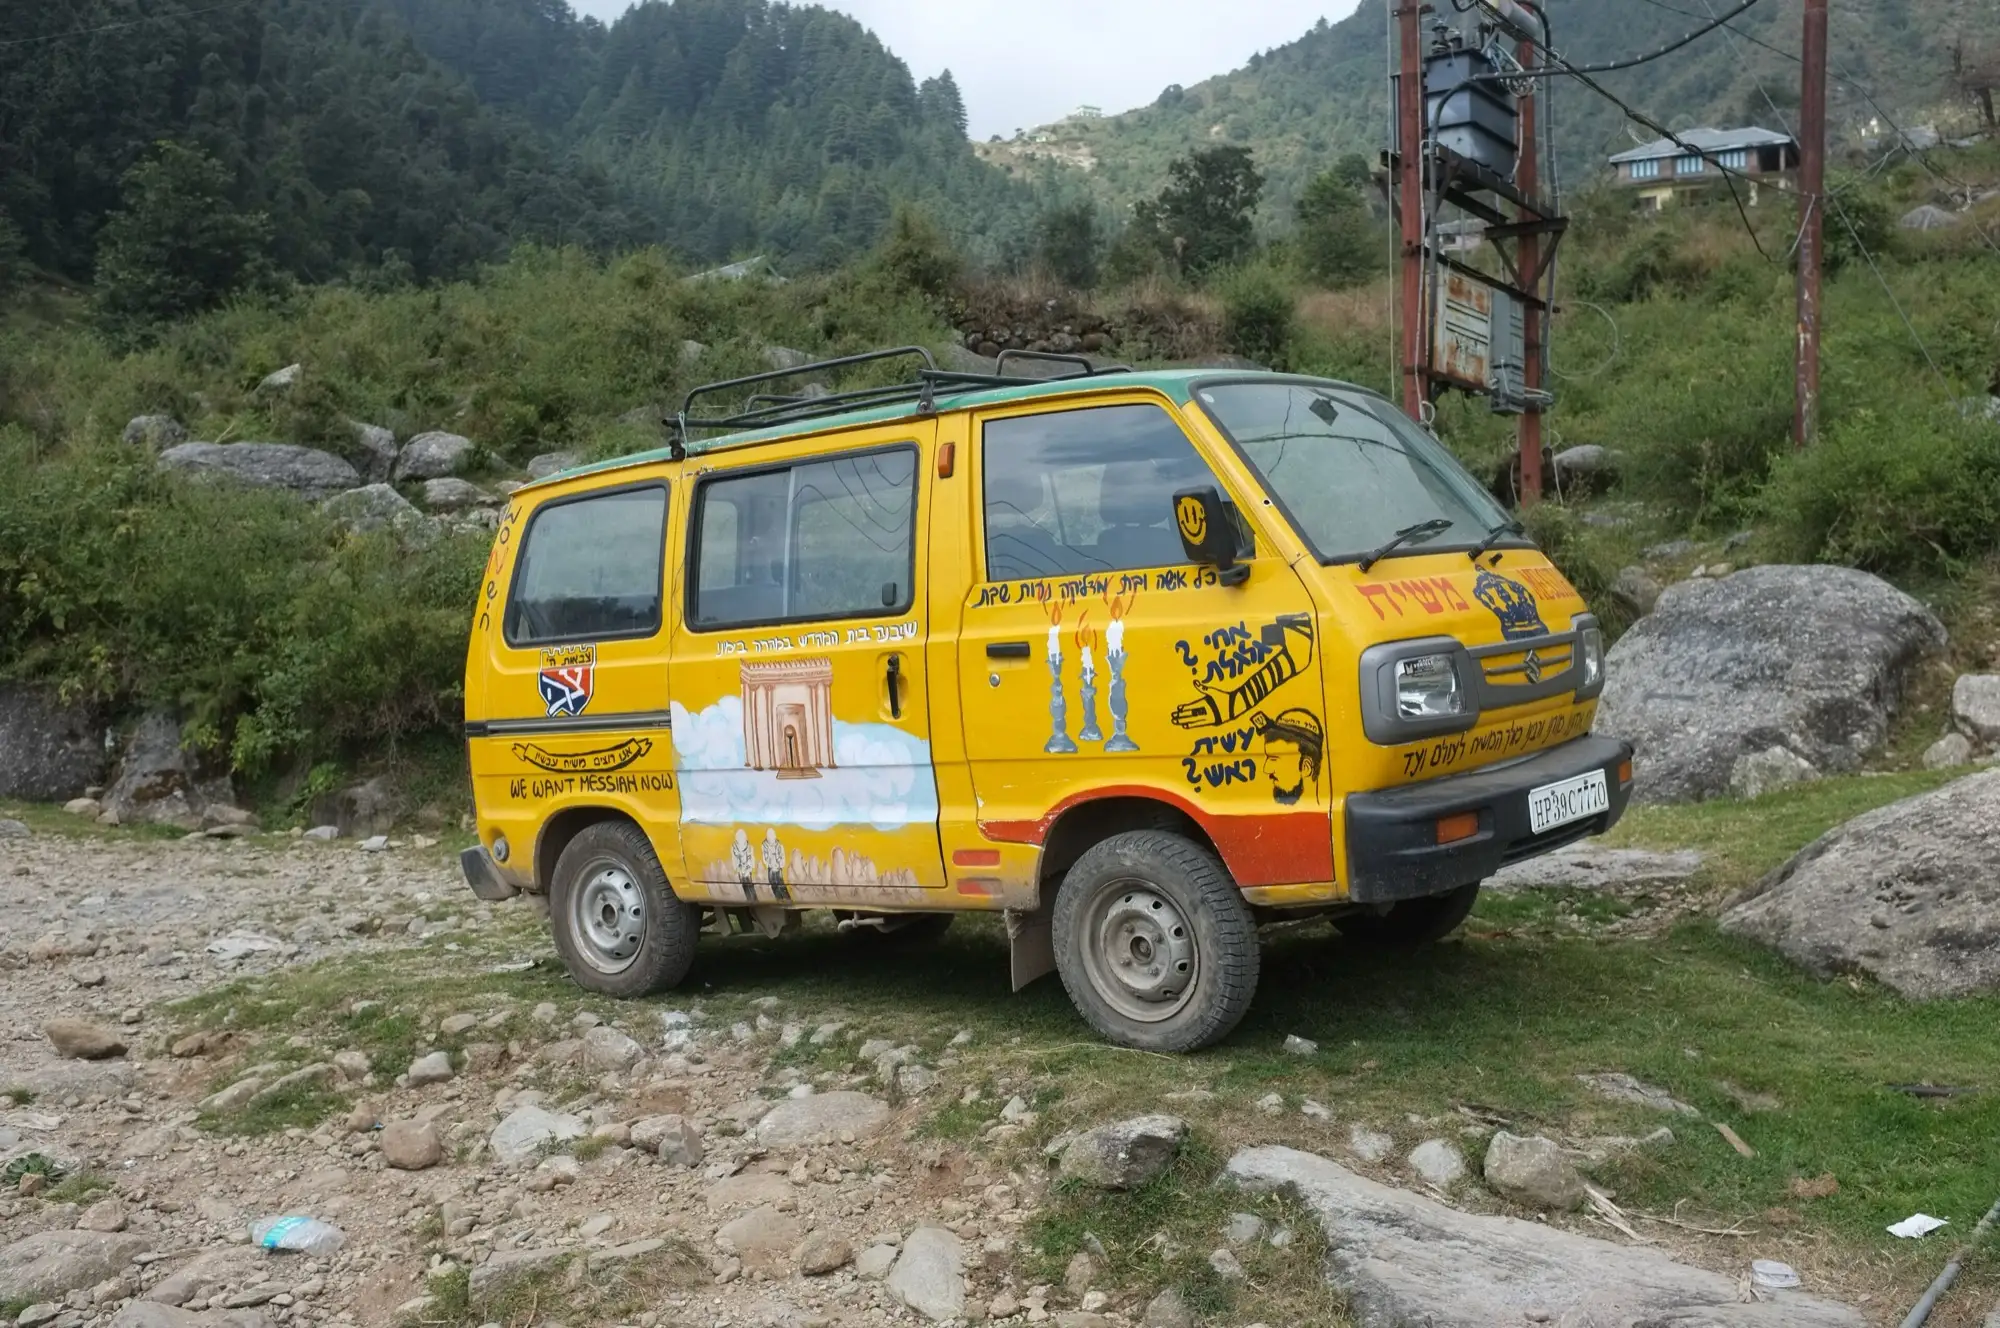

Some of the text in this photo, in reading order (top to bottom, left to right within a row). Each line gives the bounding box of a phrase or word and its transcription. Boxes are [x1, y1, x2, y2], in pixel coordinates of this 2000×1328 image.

[1193, 566, 1217, 588] כל
[971, 584, 1011, 608] שבת
[1354, 576, 1470, 621] משיח
[844, 627, 871, 645] בית
[1203, 620, 1251, 649] אחי
[1190, 726, 1255, 756] עשית
[1430, 731, 1467, 766] לעולם
[563, 756, 587, 769] משיח
[510, 773, 673, 799] WE WANT MESSIAH NOW
[1534, 781, 1606, 828] HP39C7770
